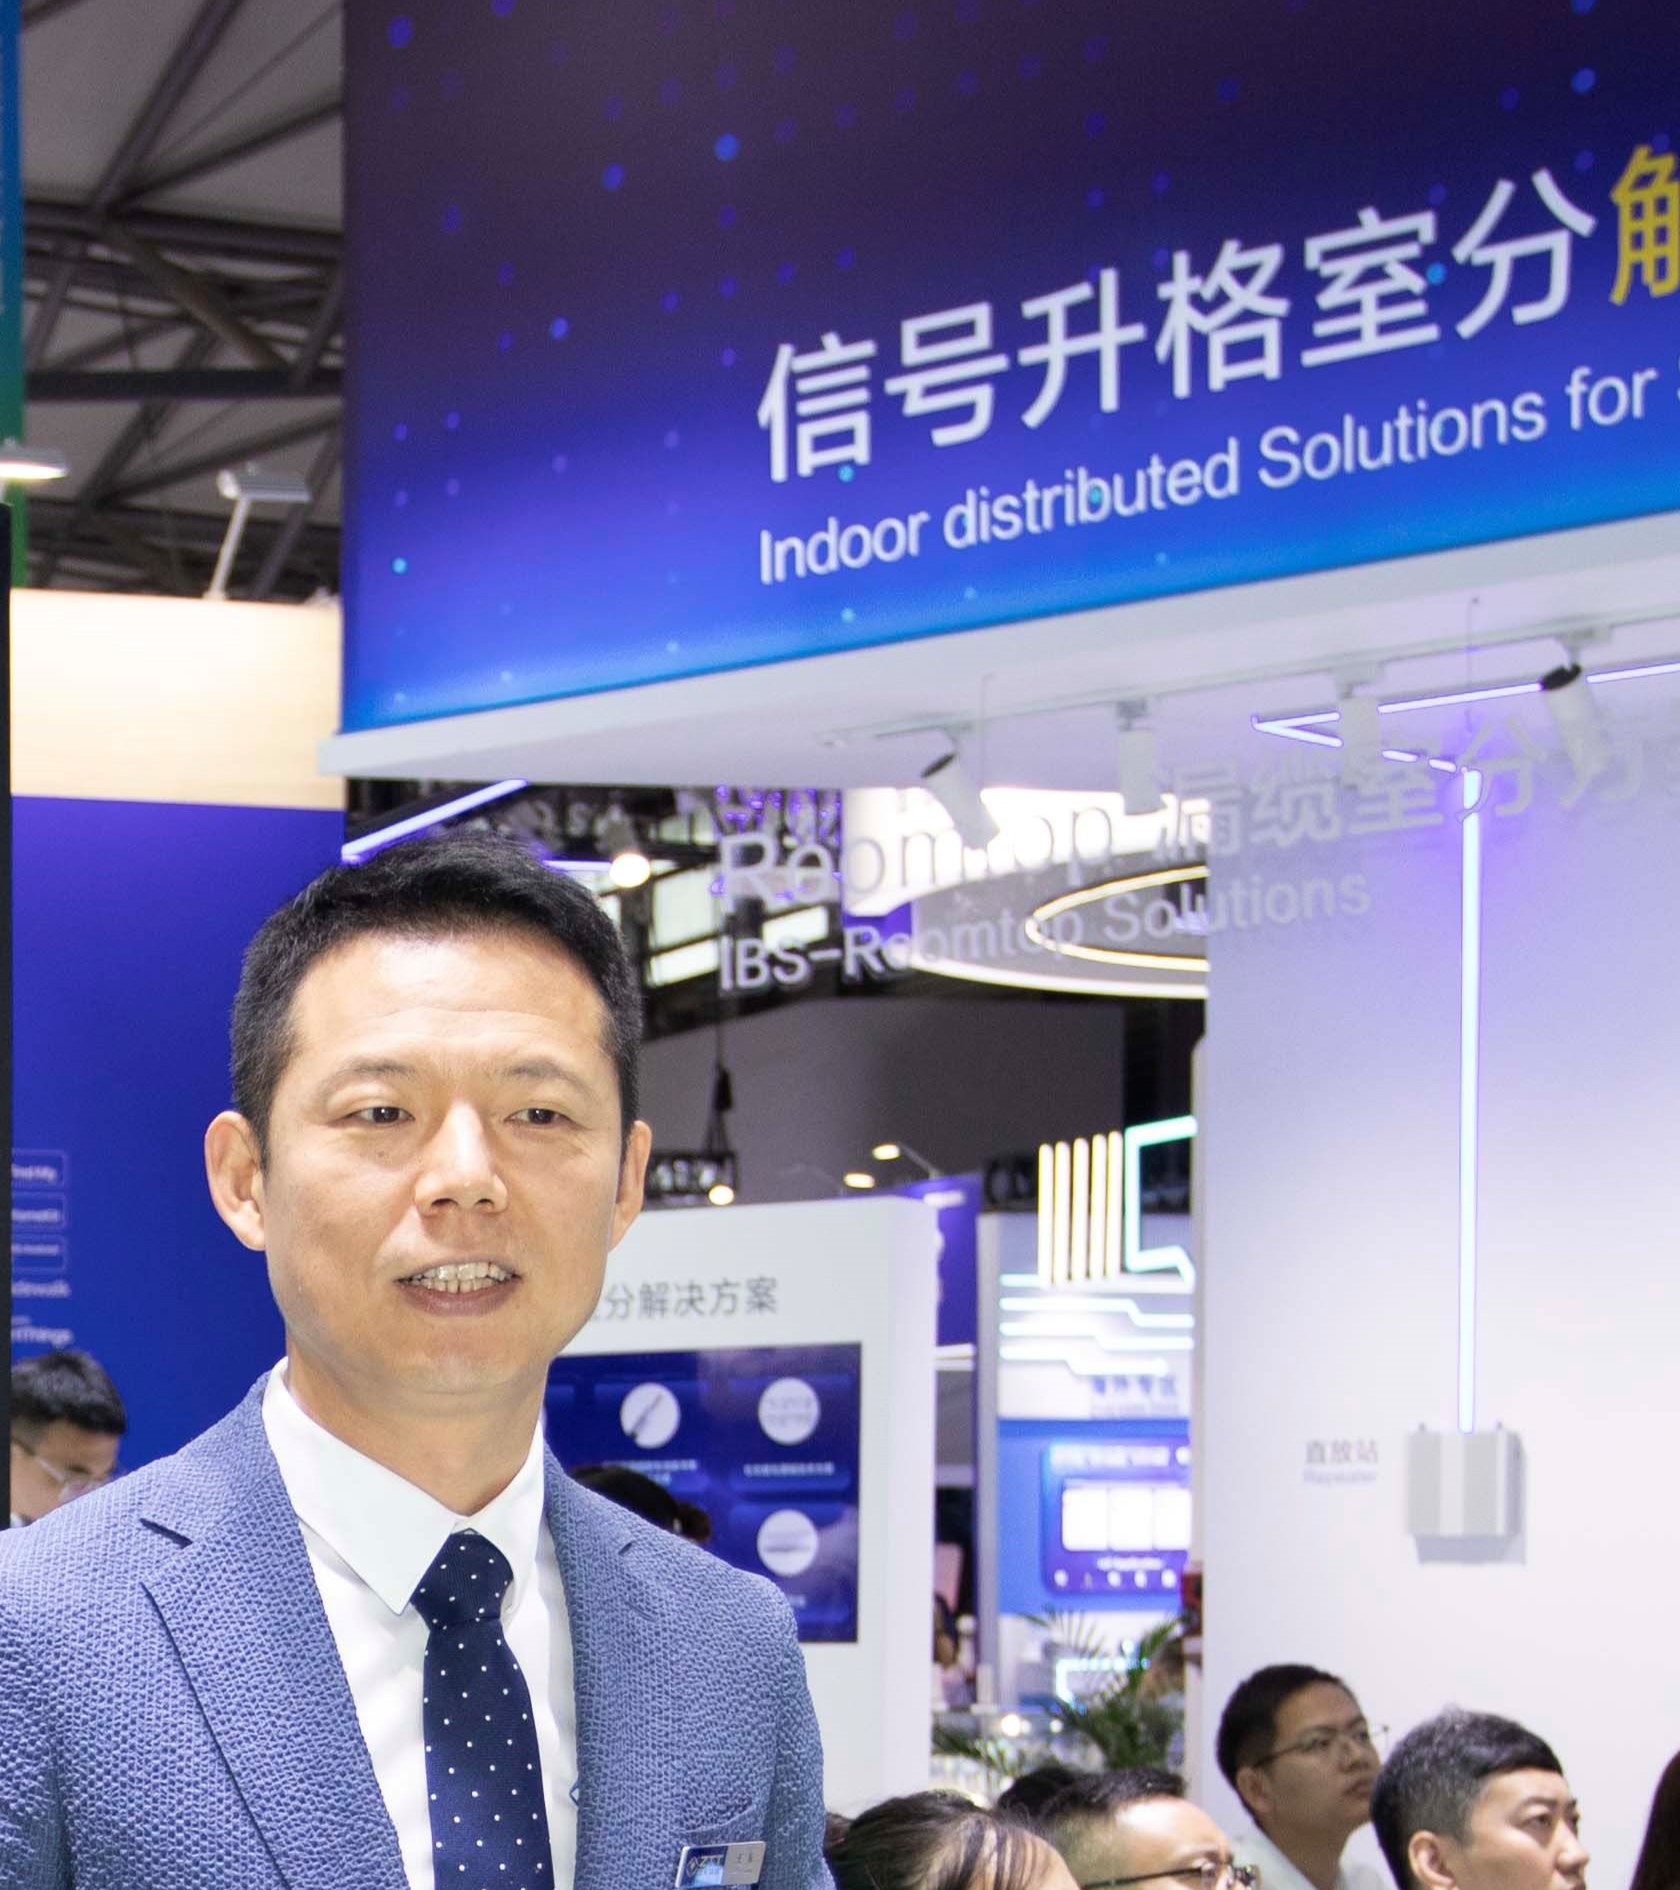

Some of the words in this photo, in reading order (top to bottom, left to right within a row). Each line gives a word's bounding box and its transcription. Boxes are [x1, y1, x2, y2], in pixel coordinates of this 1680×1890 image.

[759, 508, 931, 586] Indoor
[943, 436, 1240, 550] distributed
[1256, 390, 1545, 490] Solutions
[1564, 366, 1657, 431] for
[1101, 868, 1372, 950] Solutions
[588, 1276, 778, 1323] 分解决方案
